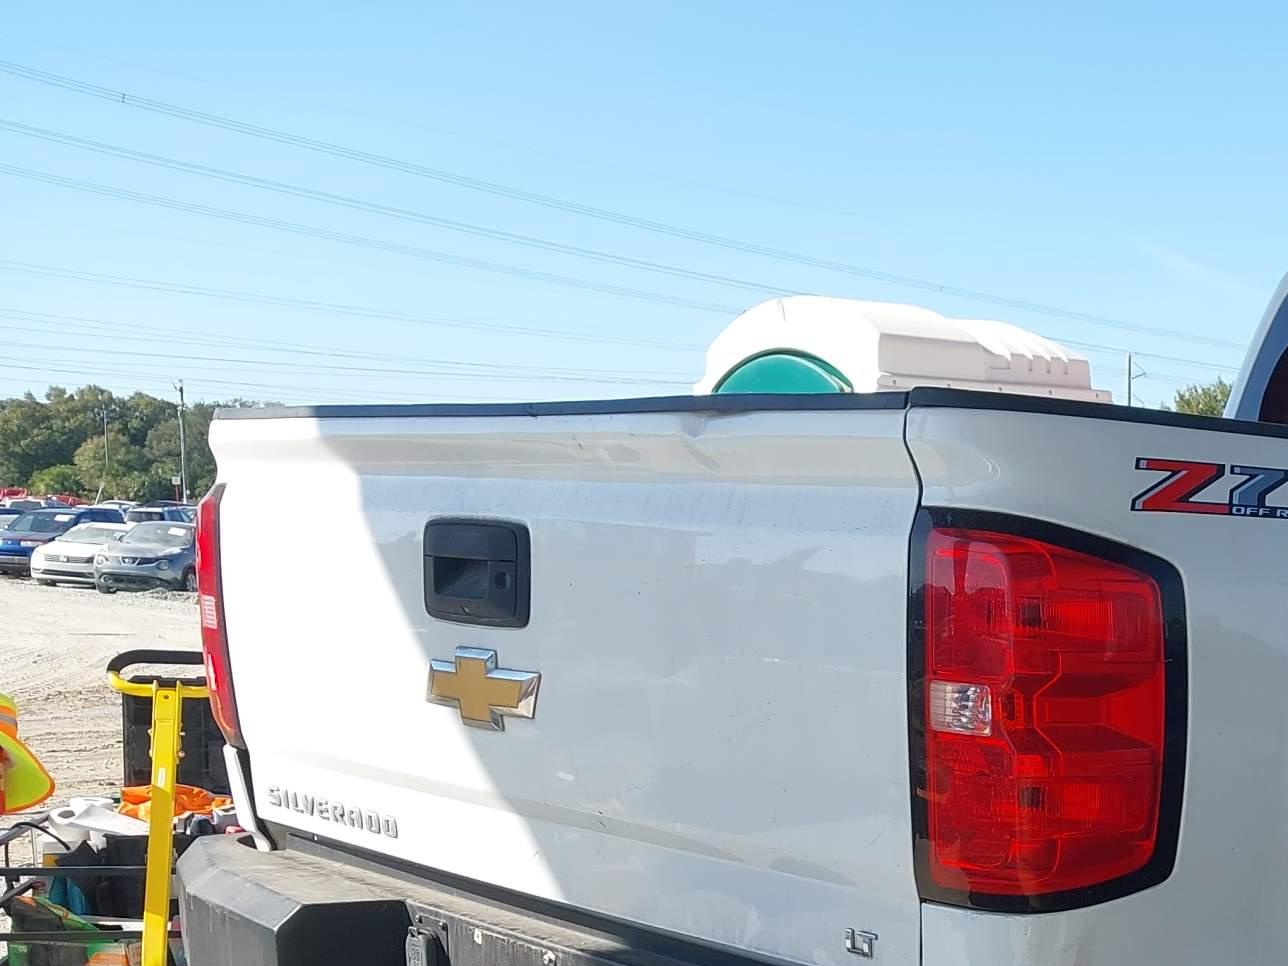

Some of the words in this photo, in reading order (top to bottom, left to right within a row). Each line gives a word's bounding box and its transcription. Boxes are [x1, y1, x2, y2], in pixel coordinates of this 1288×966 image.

[1232, 506, 1270, 516] OFF
[268, 785, 398, 838] SILVERADO
[845, 927, 879, 960] LT
